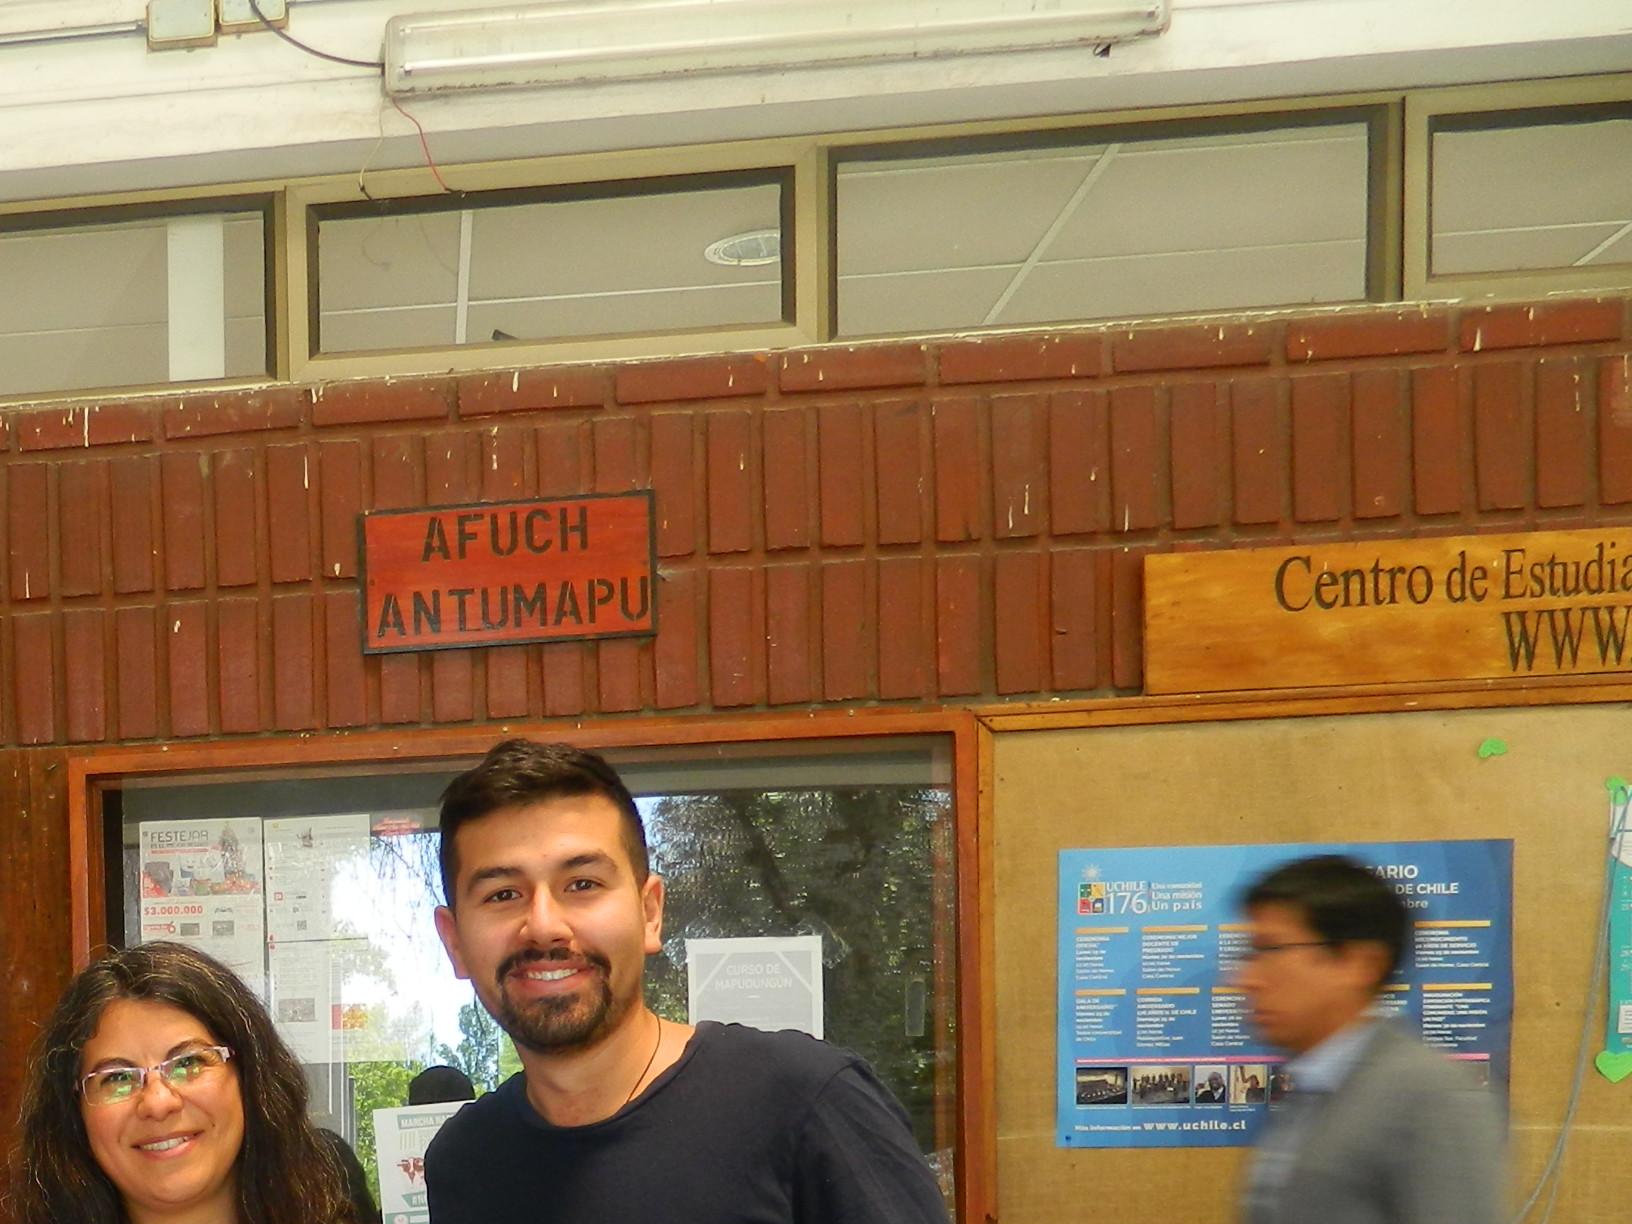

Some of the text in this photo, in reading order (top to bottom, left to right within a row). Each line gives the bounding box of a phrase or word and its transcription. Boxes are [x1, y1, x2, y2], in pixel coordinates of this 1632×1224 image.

[421, 506, 588, 562] AFUCH
[1274, 555, 1434, 612] Centro
[1446, 550, 1489, 602] de
[377, 575, 649, 638] ANTUMAPU
[1106, 881, 1147, 892] UCHILE
[1395, 882, 1459, 895] DE CHILE
[1107, 891, 1147, 914] 176
[1151, 900, 1203, 912] Un país
[726, 962, 781, 976] CURSO DE
[1143, 1120, 1246, 1131] www.uchile.cl
